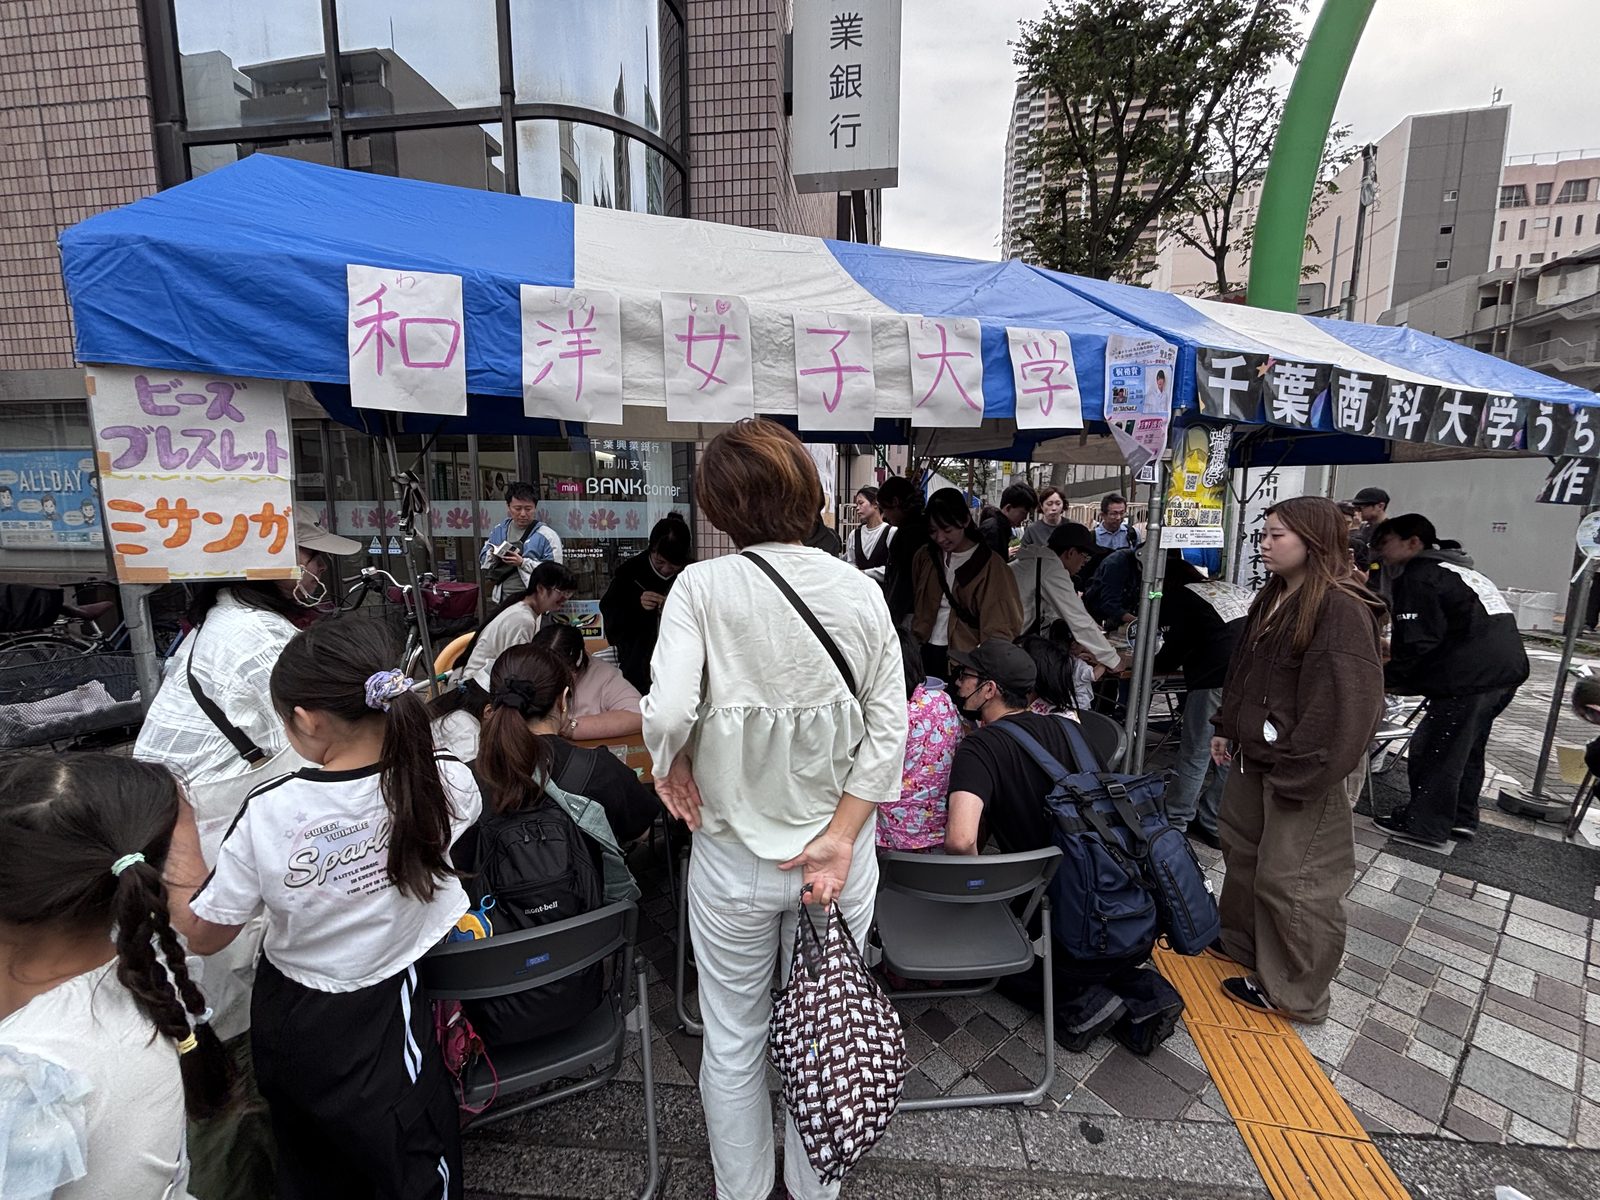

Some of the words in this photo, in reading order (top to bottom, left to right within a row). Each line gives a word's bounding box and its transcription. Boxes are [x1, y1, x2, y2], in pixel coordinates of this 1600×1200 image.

[829, 12, 863, 149] 業銀行
[134, 375, 248, 423] ビーズ
[100, 425, 289, 474] ブレスレット
[590, 439, 660, 453] 千葉興業銀行
[604, 459, 652, 471] 市川支店
[561, 483, 578, 492] mini
[585, 477, 642, 495] BANK
[643, 485, 681, 497] corner
[1550, 458, 1590, 503] 作
[107, 497, 292, 555] ミサンガ
[304, 821, 340, 839] SWEET
[325, 821, 369, 842] TWINKLE
[338, 868, 359, 879] LITTLE
[829, 1032, 843, 1040] moz
